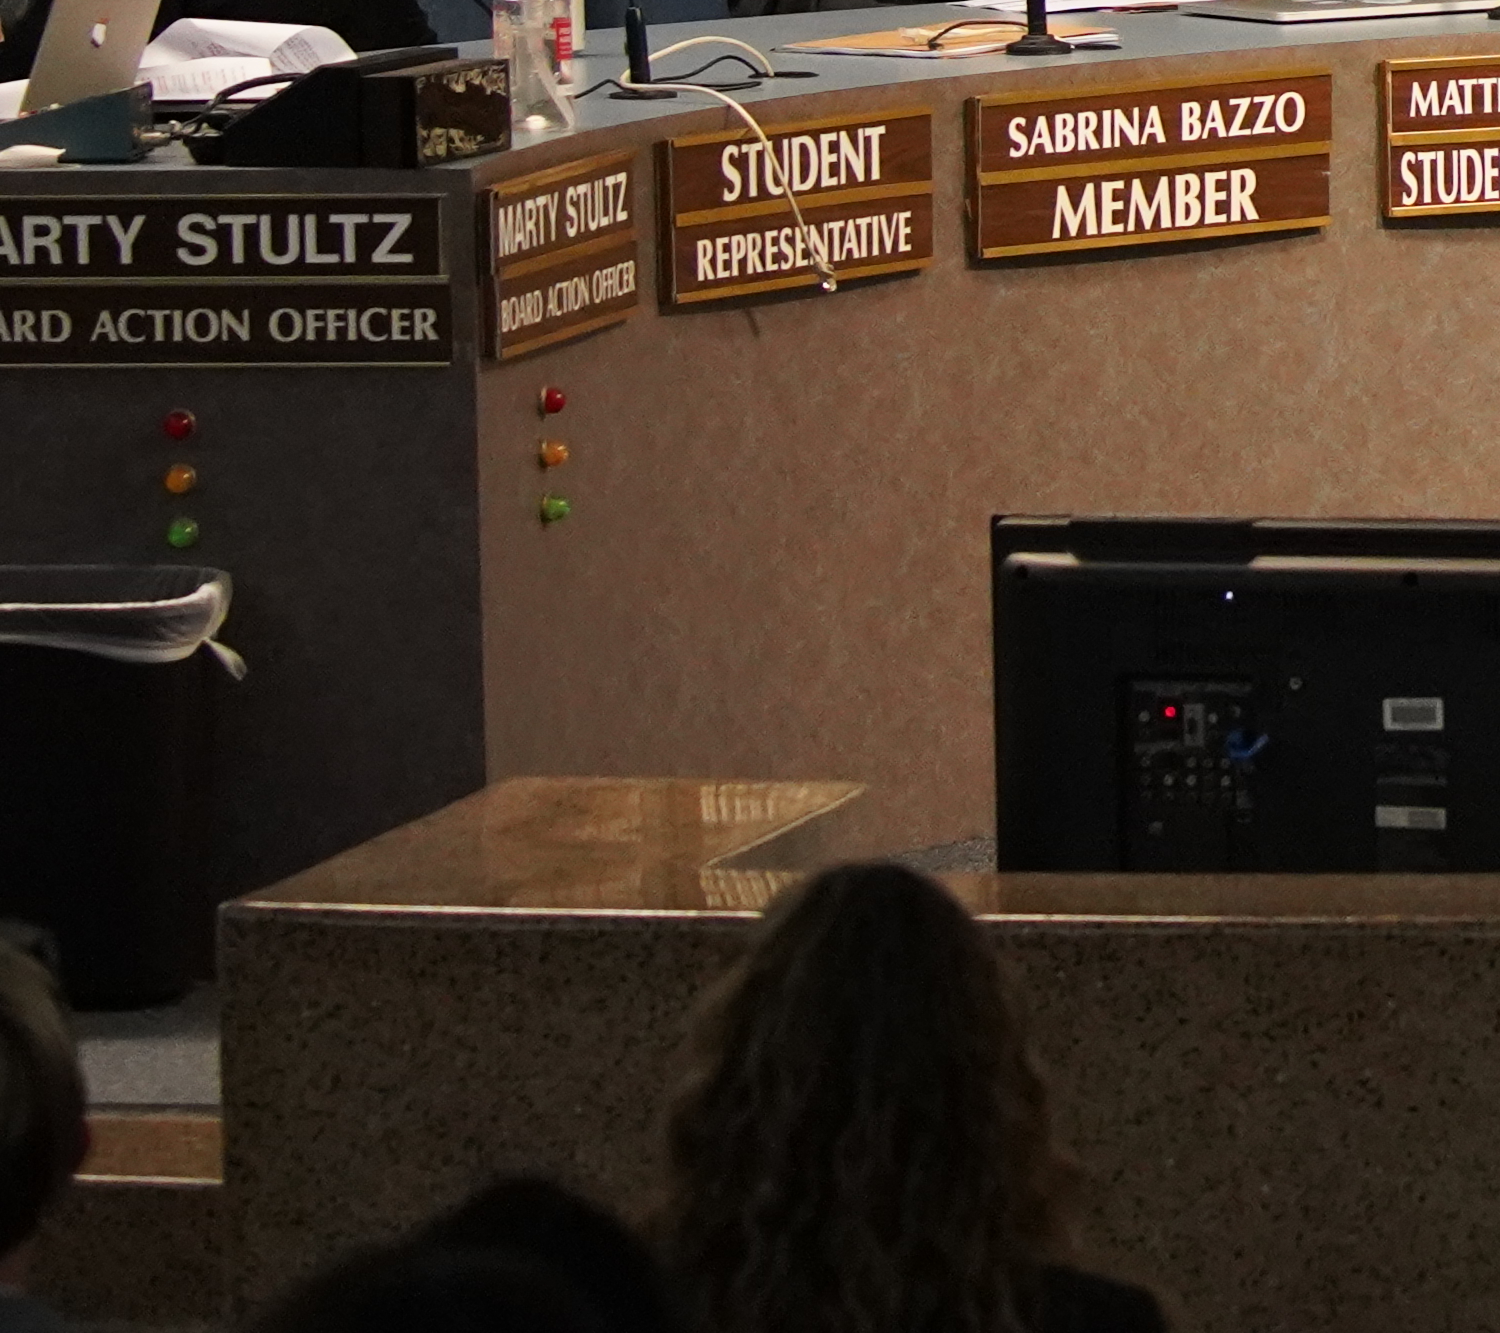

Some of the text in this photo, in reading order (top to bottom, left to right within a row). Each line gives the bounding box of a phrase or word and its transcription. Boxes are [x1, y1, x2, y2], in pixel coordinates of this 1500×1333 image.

[1008, 91, 1306, 158] SABRINA BAZZO
[721, 124, 887, 203] STUDENT
[176, 212, 414, 266] STULTZ
[498, 171, 628, 258] MARTY STULTZ
[1051, 167, 1260, 240] MEMBER
[696, 210, 912, 281] REPRESENTATIVE
[90, 308, 253, 343] ACTION
[269, 307, 440, 342] OFFICER
[501, 259, 636, 333] BOARD ACTION OFFICER
